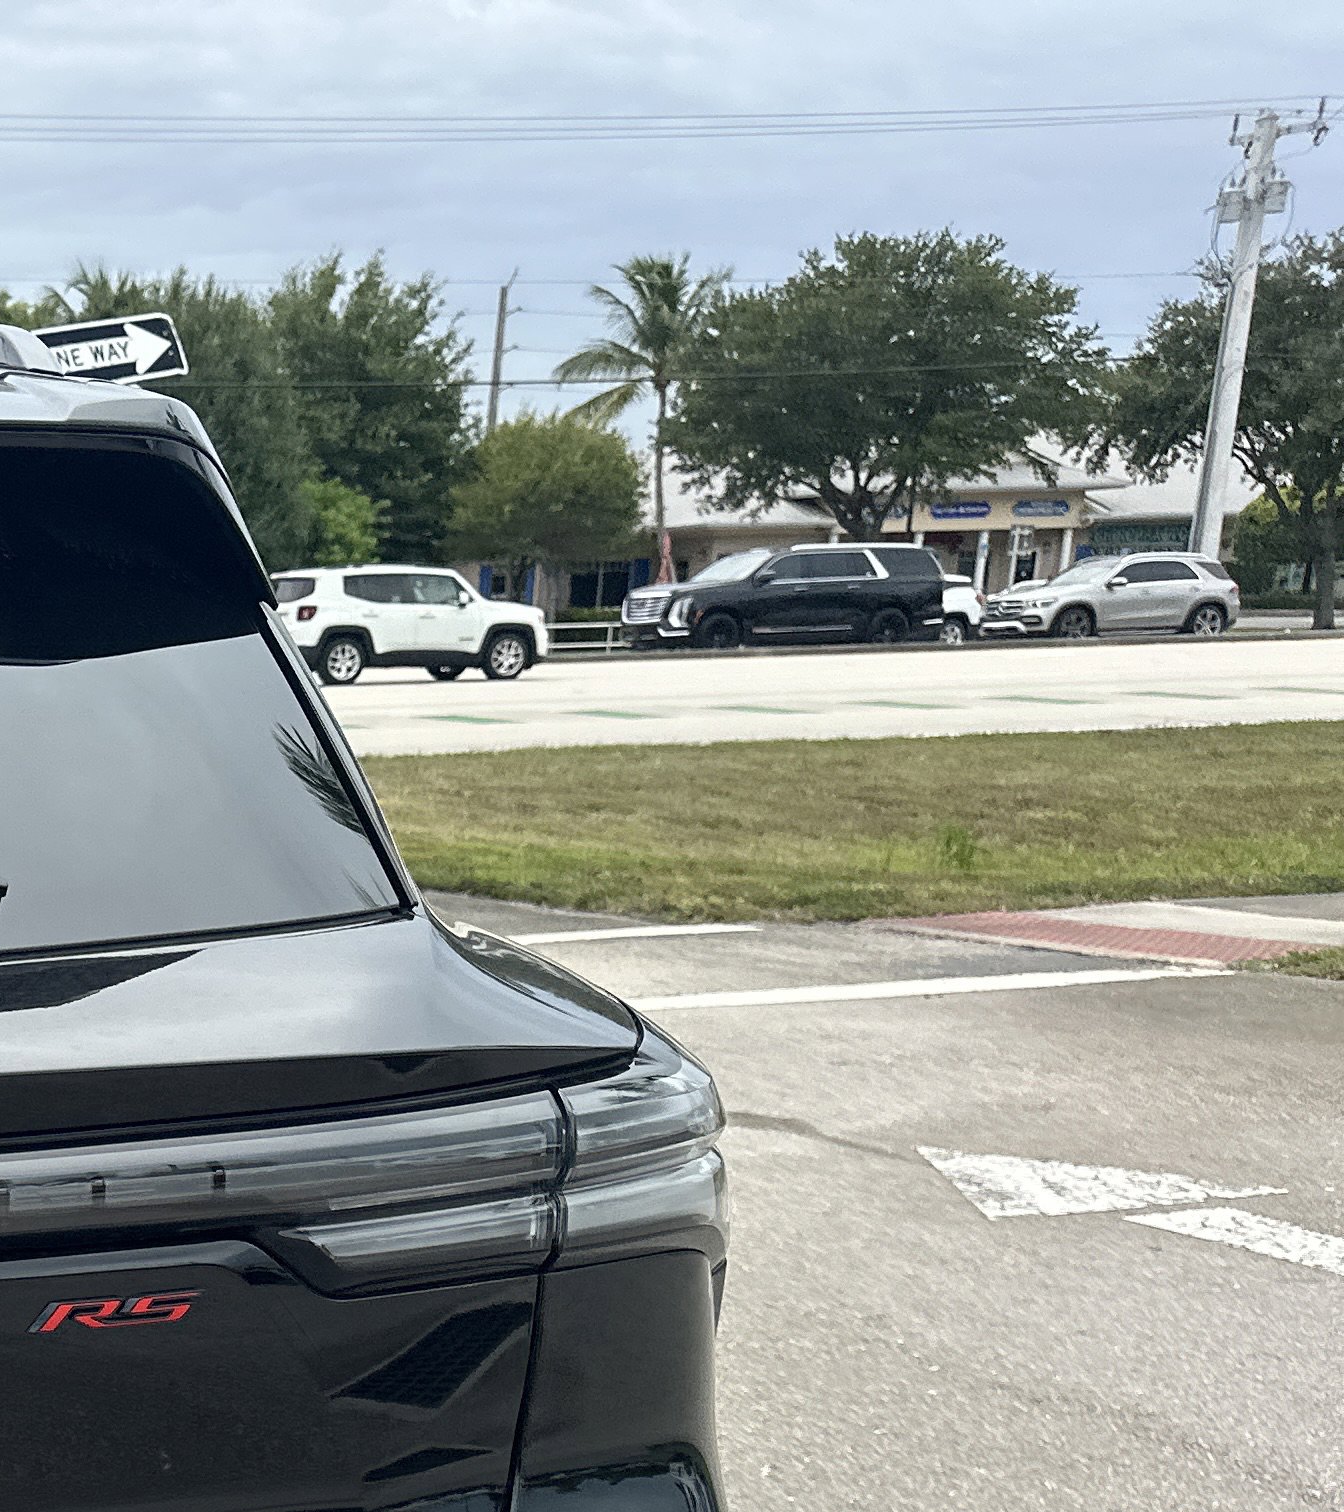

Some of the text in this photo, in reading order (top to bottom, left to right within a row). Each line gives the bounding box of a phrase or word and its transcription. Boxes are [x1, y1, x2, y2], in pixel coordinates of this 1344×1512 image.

[55, 341, 129, 367] NE WAY
[26, 1289, 204, 1334] RS
